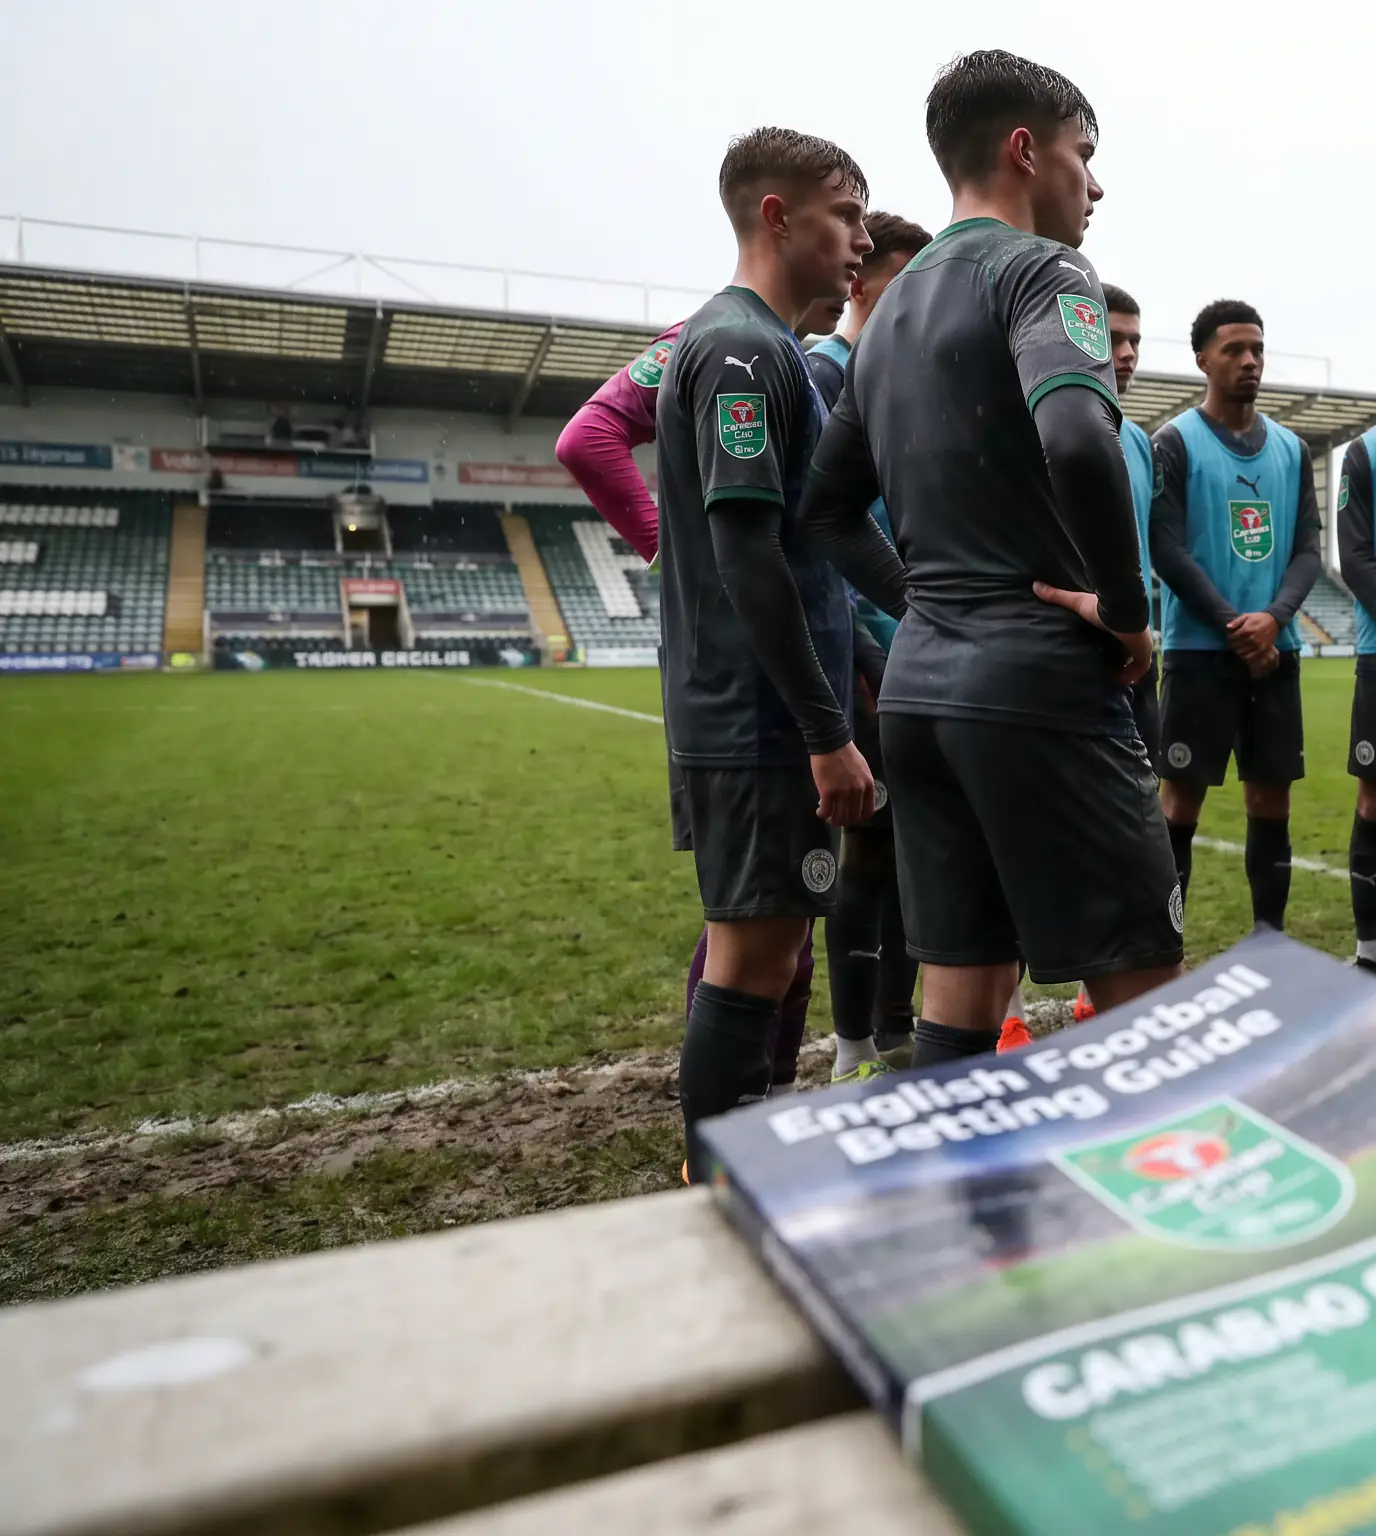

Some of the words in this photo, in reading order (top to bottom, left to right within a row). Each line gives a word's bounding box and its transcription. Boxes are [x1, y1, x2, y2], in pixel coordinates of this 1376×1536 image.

[767, 1067, 1028, 1146] English
[1025, 963, 1272, 1083] Football
[833, 1084, 1110, 1165] Betting
[1102, 1007, 1282, 1096] Guide
[1022, 1282, 1371, 1420] CARABAO
